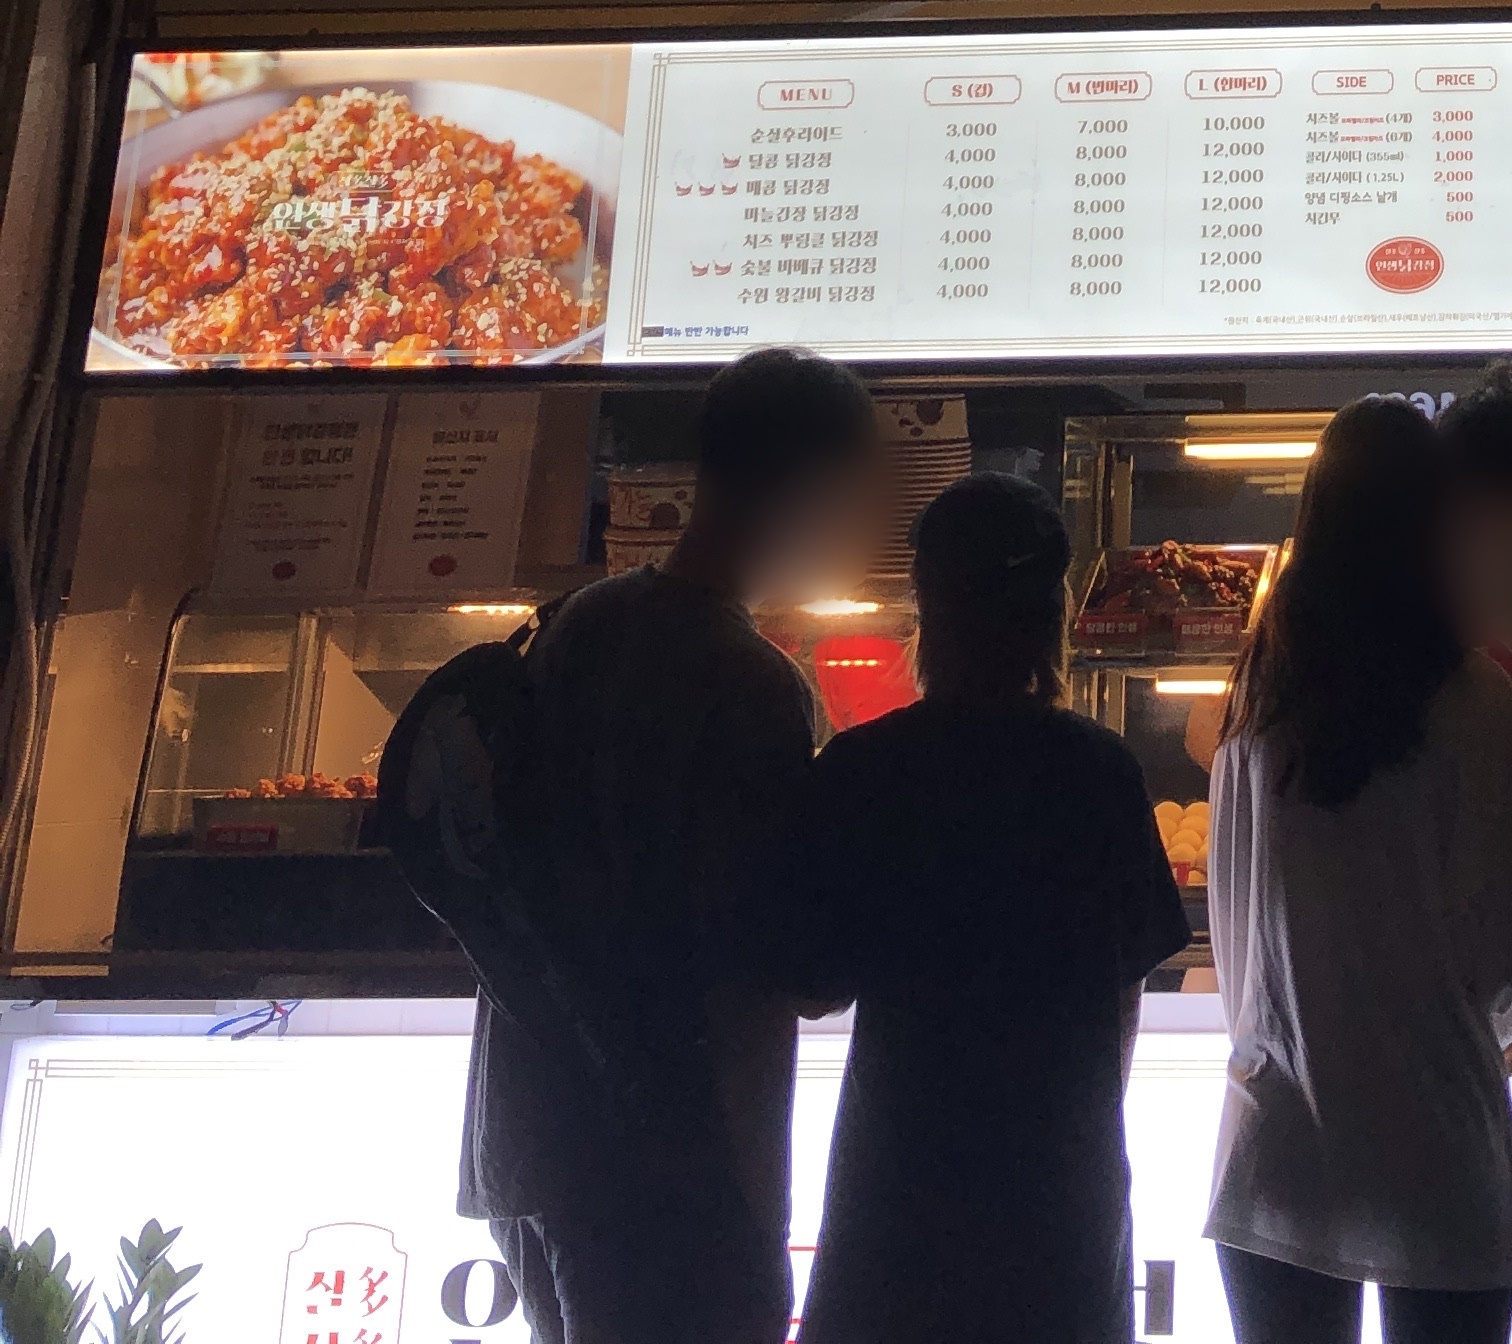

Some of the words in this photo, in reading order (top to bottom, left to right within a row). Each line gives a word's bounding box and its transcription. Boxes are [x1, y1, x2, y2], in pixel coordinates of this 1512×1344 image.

[1067, 81, 1081, 95] M
[1199, 78, 1208, 91] L
[1213, 76, 1268, 92] (한마리)
[1336, 76, 1367, 88] SIDE
[1436, 74, 1475, 86] PRICE
[780, 88, 833, 101] MENU
[952, 84, 962, 98] S
[1203, 116, 1265, 132] 10,000
[1432, 110, 1474, 124] 3,000
[946, 122, 997, 137] 3,000
[1078, 119, 1128, 135] 7,000
[1431, 130, 1474, 143] 4,000
[944, 148, 996, 164] 4,000
[1076, 145, 1127, 161] 8,000
[1203, 142, 1264, 158] 12,000
[1435, 150, 1474, 163] 1,000
[785, 152, 832, 169] 닭강정
[942, 175, 995, 191] 4,000
[1074, 172, 1126, 188] 8,000
[1202, 169, 1264, 185] 12,000
[1433, 170, 1474, 183] 2,000
[783, 178, 830, 196] 닭강정
[1201, 196, 1263, 213] 12,000
[1305, 191, 1326, 205] 양념
[1330, 191, 1373, 204] 디핑소스
[1446, 191, 1474, 203] 500
[744, 205, 806, 223] 마늘간장
[813, 204, 860, 222] 닭강정
[941, 202, 993, 218] 4,000
[1073, 199, 1125, 215] 8,000
[1445, 210, 1474, 222] 500
[939, 229, 992, 245] 4,000
[1072, 226, 1124, 242] 8,000
[1200, 223, 1263, 240] 12,000
[743, 233, 773, 250] 치즈
[831, 230, 879, 248] 닭강정
[777, 258, 823, 276] 바베큐
[829, 257, 877, 275] 닭강정
[937, 256, 991, 273] 4,000
[1070, 253, 1123, 270] 8,000
[1199, 250, 1262, 268] 12,000
[936, 283, 989, 300] 4,000
[1069, 280, 1122, 297] 8,000
[1198, 277, 1262, 295] 12,000
[775, 286, 822, 304] 왕갈비
[828, 285, 876, 303] 닭강정
